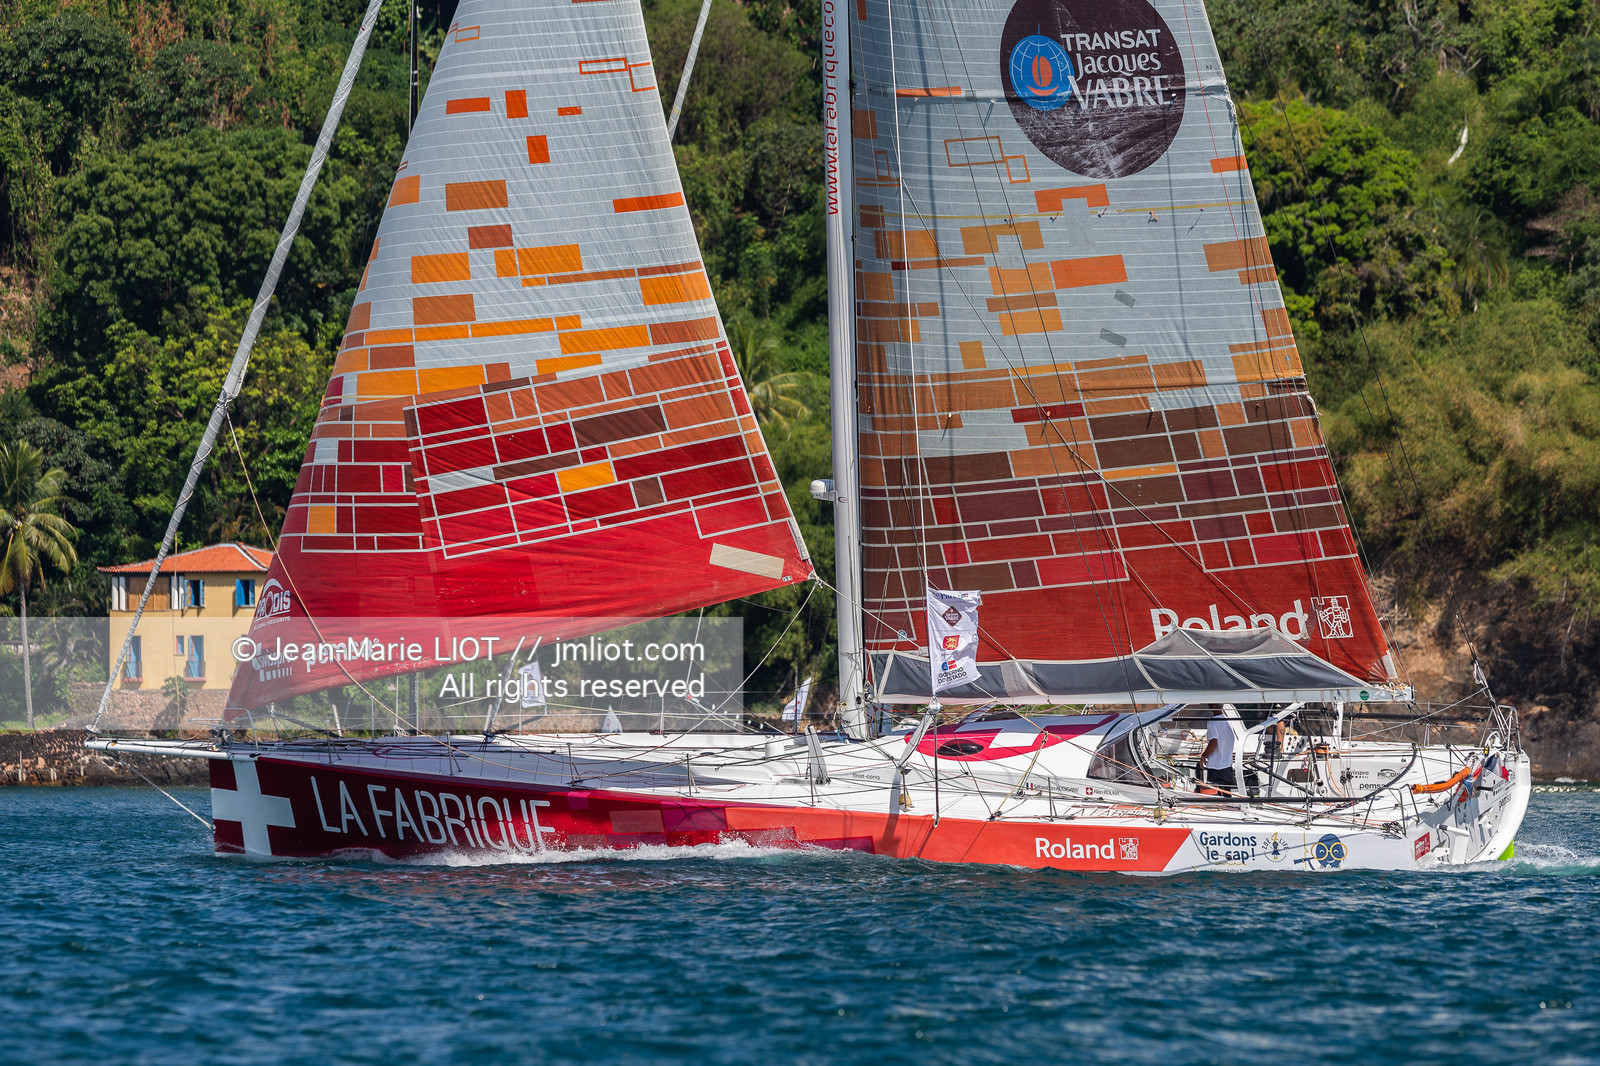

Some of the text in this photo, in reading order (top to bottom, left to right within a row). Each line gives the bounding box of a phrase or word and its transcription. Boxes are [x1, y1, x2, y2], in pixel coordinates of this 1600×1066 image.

[1060, 29, 1161, 52] TRANSAT
[1076, 52, 1162, 81] Jacques
[1067, 75, 1173, 110] VABRE
[310, 776, 557, 851] LA FABRIQUE
[1034, 837, 1116, 860] Roland
[1199, 831, 1257, 847] Gardons
